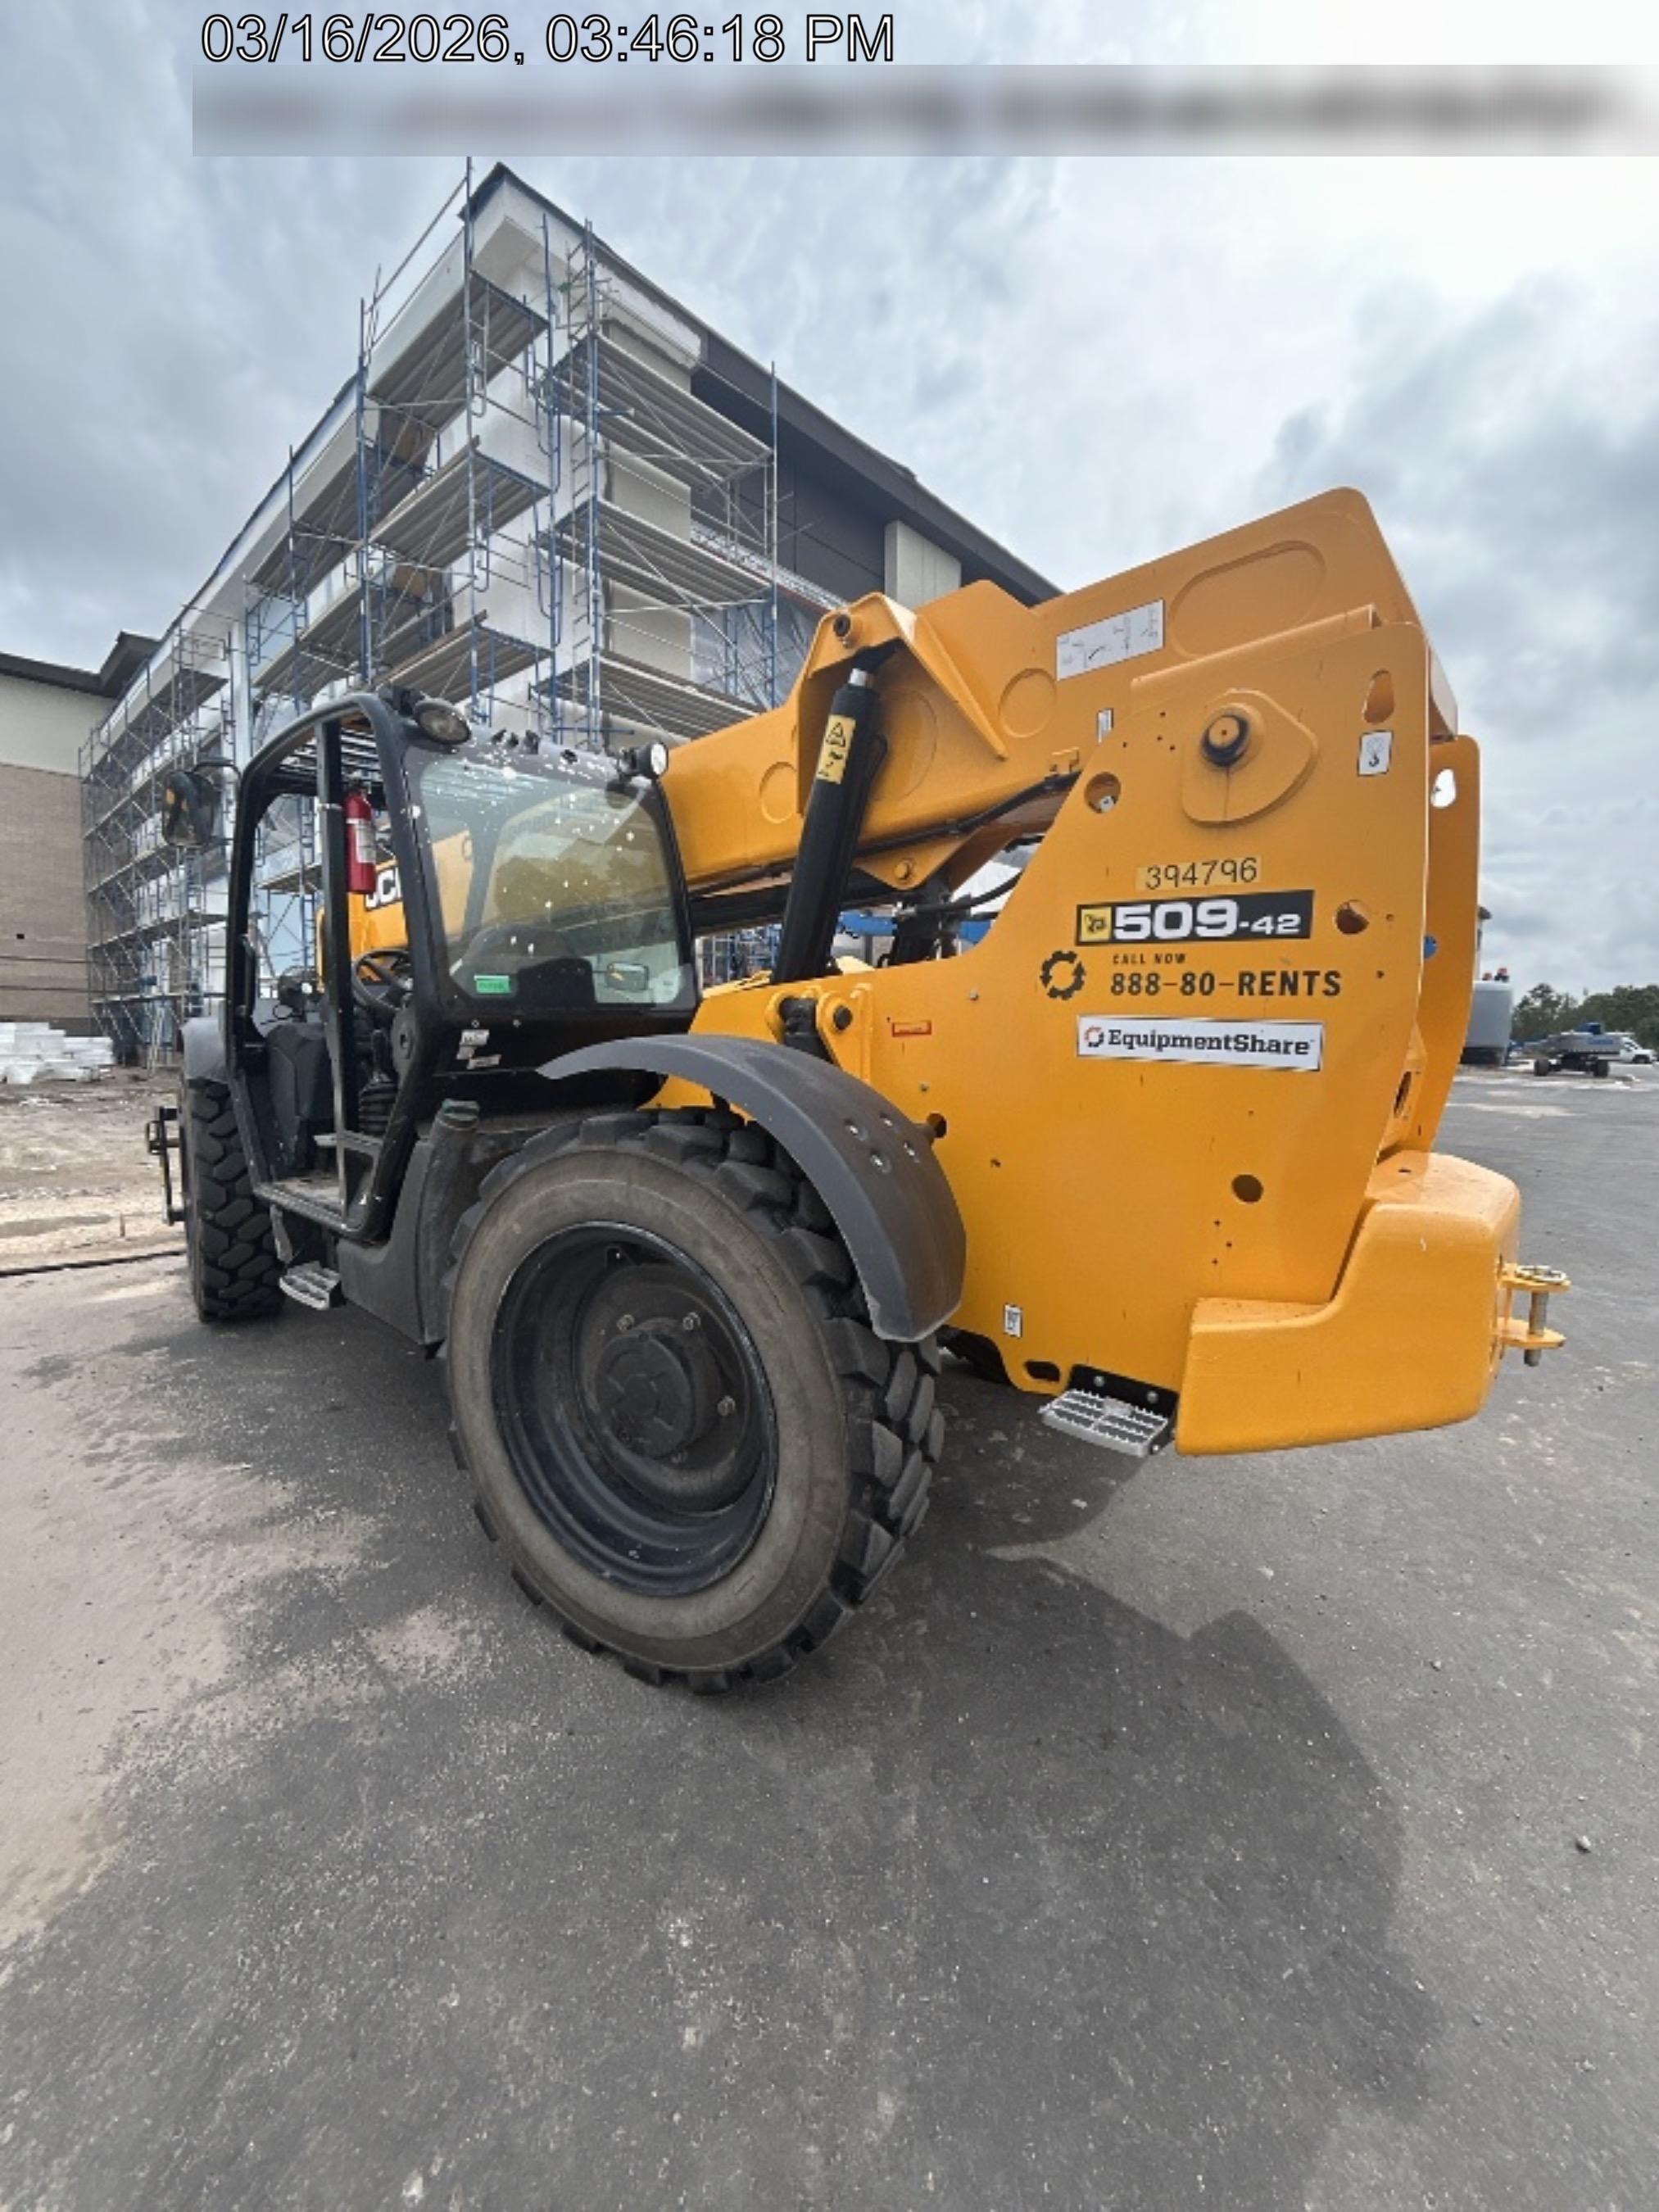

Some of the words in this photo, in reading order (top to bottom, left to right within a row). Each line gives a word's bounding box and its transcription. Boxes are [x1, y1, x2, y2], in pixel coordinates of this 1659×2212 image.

[1146, 857, 1258, 891] 394796
[1113, 898, 1301, 941] 509-42
[1113, 953, 1146, 965] CALL
[1154, 953, 1186, 964] NOW
[1110, 970, 1342, 997] 888-80-RENTS
[1108, 1029, 1310, 1055] EquipmentShare
